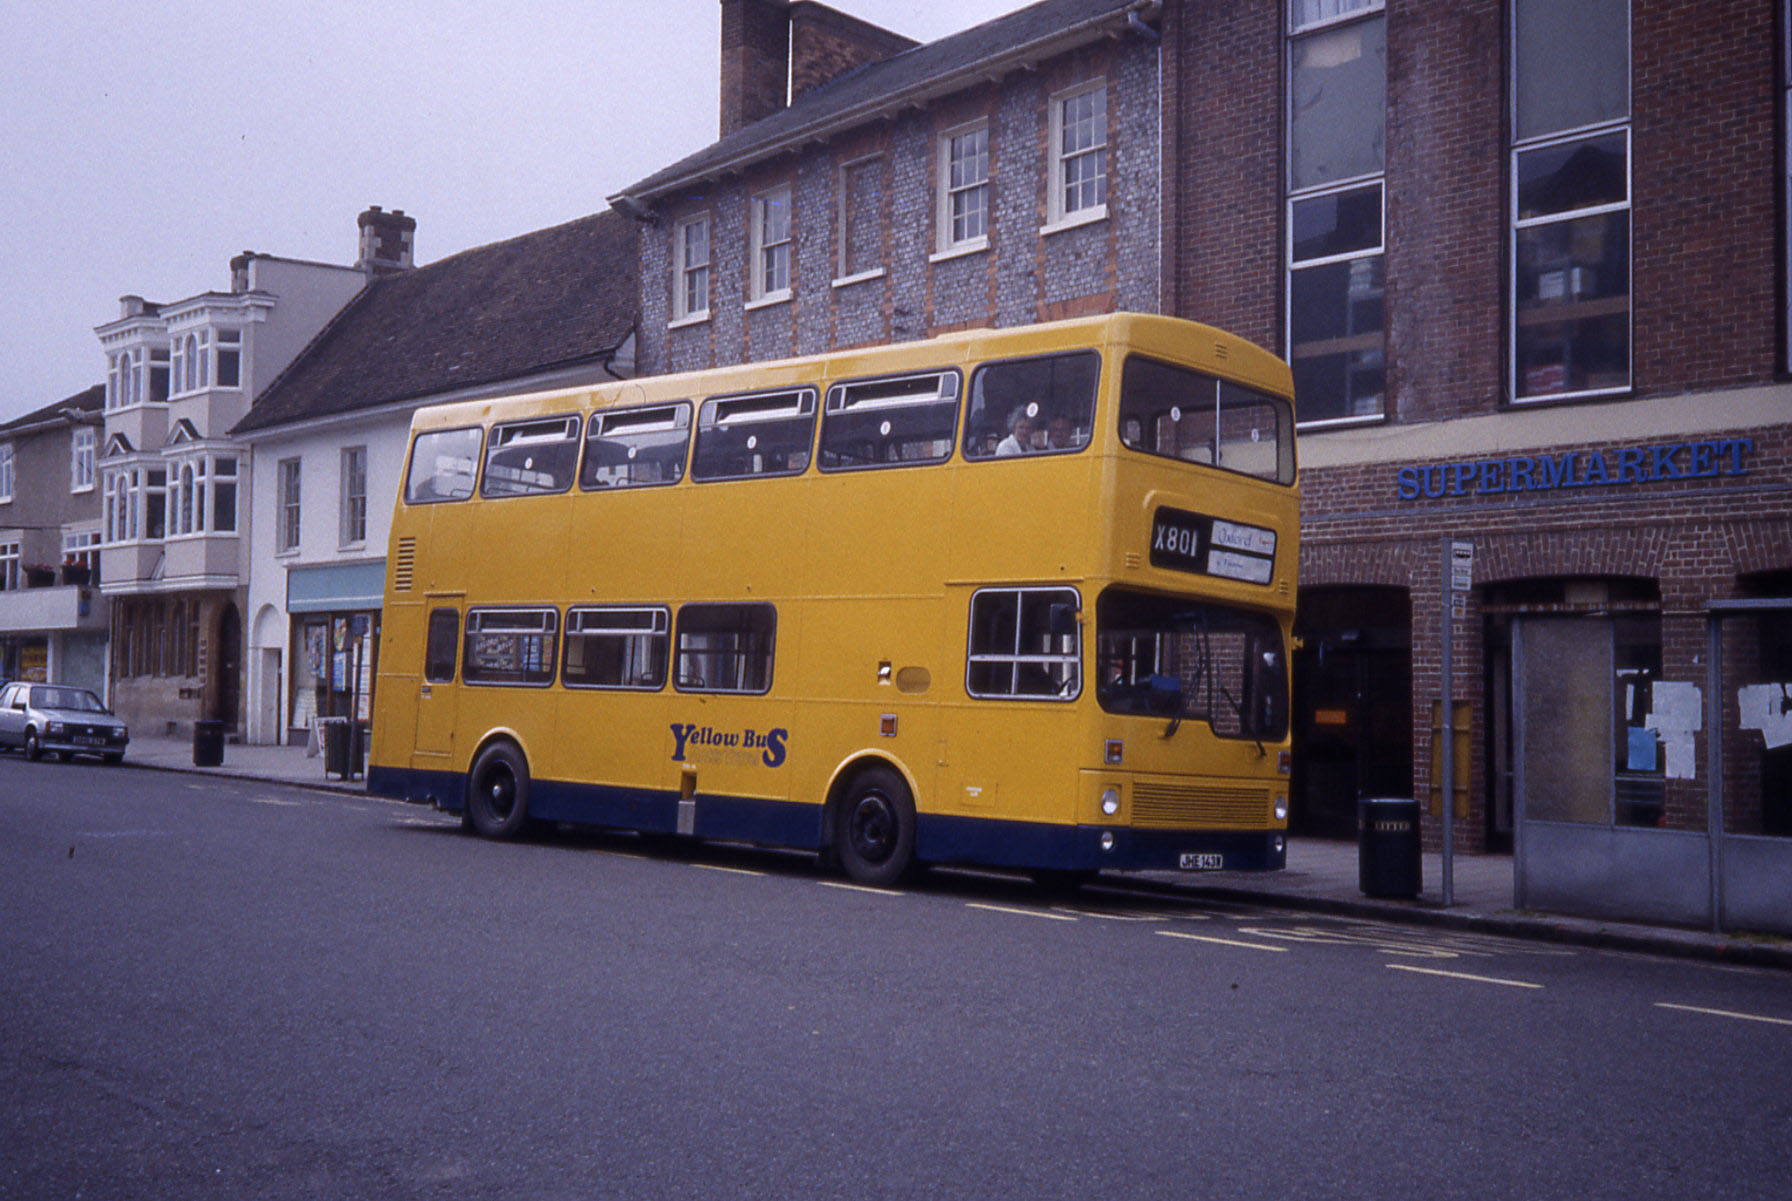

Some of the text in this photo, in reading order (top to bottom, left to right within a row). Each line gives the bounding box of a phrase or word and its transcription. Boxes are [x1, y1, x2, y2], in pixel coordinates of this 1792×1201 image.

[1397, 438, 1753, 500] SUPERMARKET
[1155, 524, 1198, 558] X801
[670, 723, 740, 761] Yellow
[1182, 855, 1200, 868] JHE
